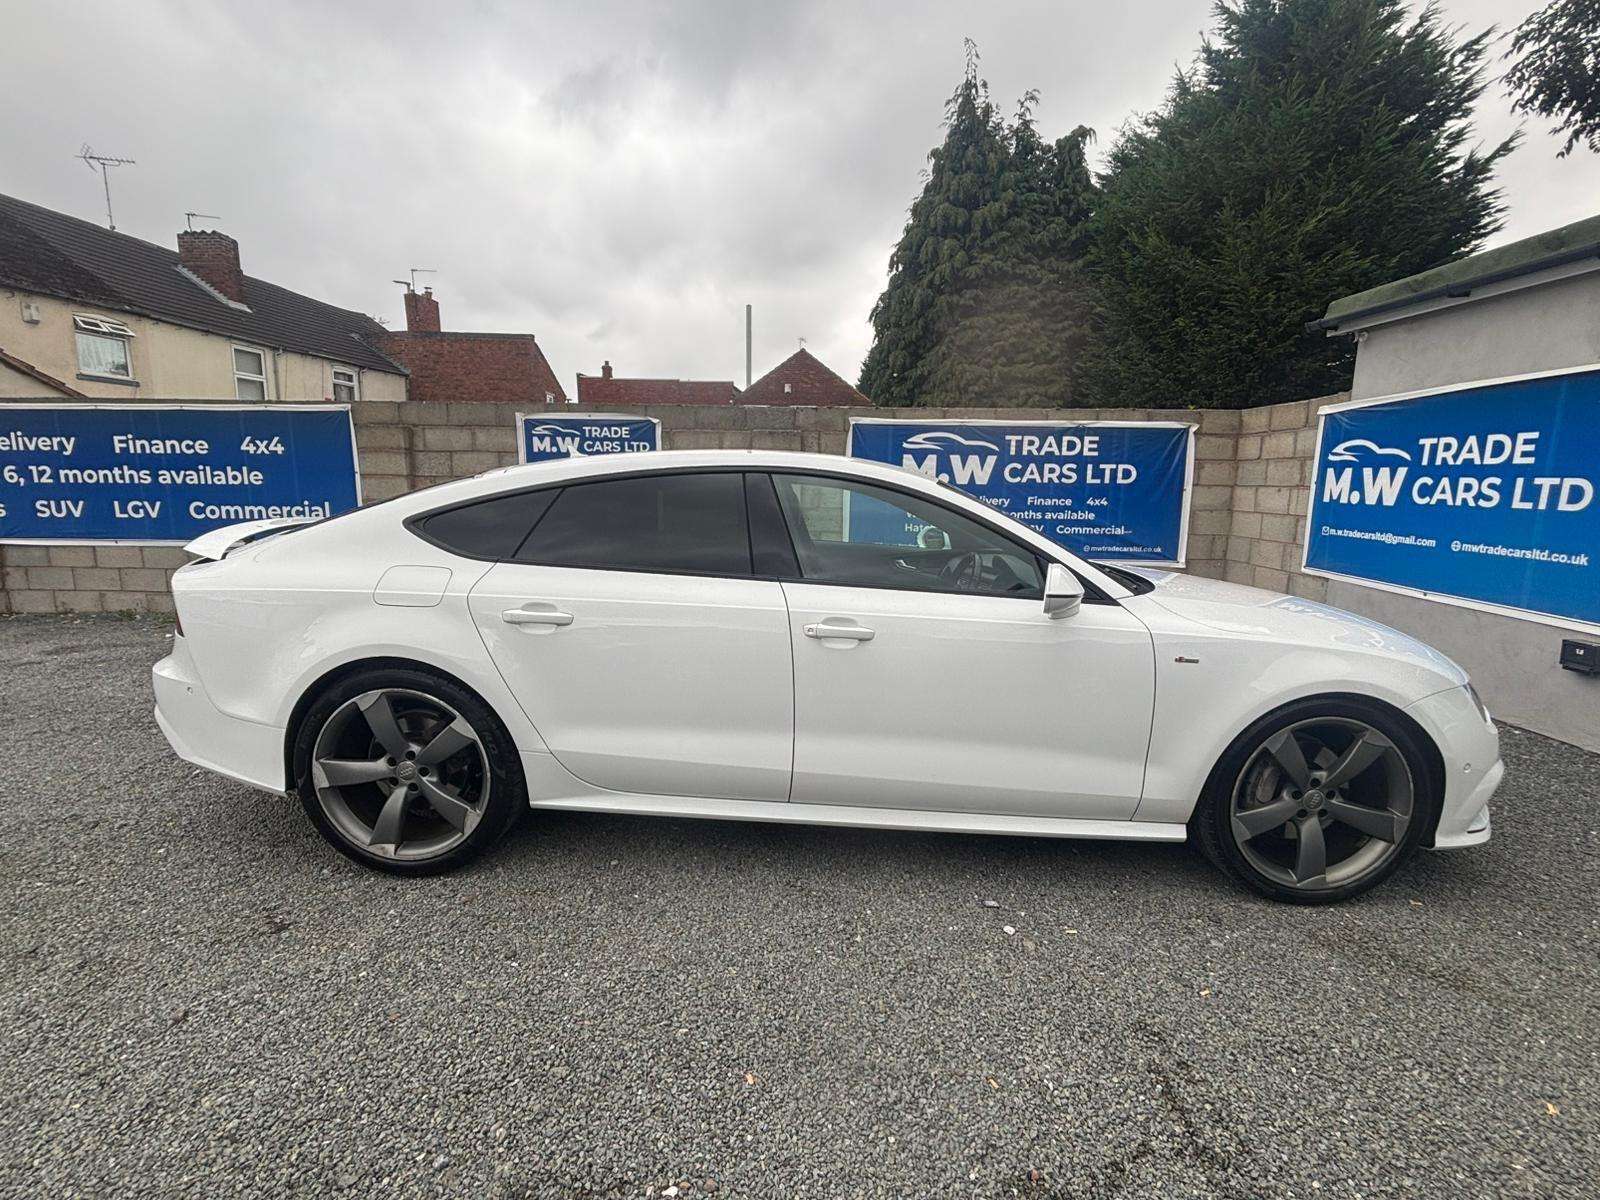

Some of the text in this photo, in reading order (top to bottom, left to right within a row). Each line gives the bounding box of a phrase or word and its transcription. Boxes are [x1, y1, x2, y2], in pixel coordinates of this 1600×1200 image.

[582, 426, 630, 438] TRADE
[0, 431, 285, 456] elivery Finance 4x4
[583, 441, 650, 453] CARS LTD
[1005, 435, 1100, 457] TRADE
[1418, 431, 1540, 466] TRADE
[28, 465, 54, 484] 12
[58, 466, 152, 485] months
[158, 466, 264, 486] available
[1003, 463, 1078, 485] CARS
[1086, 464, 1138, 485] LTD
[1323, 466, 1595, 512] M.W CARS LTD
[35, 500, 330, 520] SUV LGV Commercial
[1027, 496, 1073, 507] Finance
[1086, 496, 1109, 507] 4x4
[1010, 510, 1096, 521] onths available
[1461, 542, 1589, 566] mwtradecarsltd.co.uk
